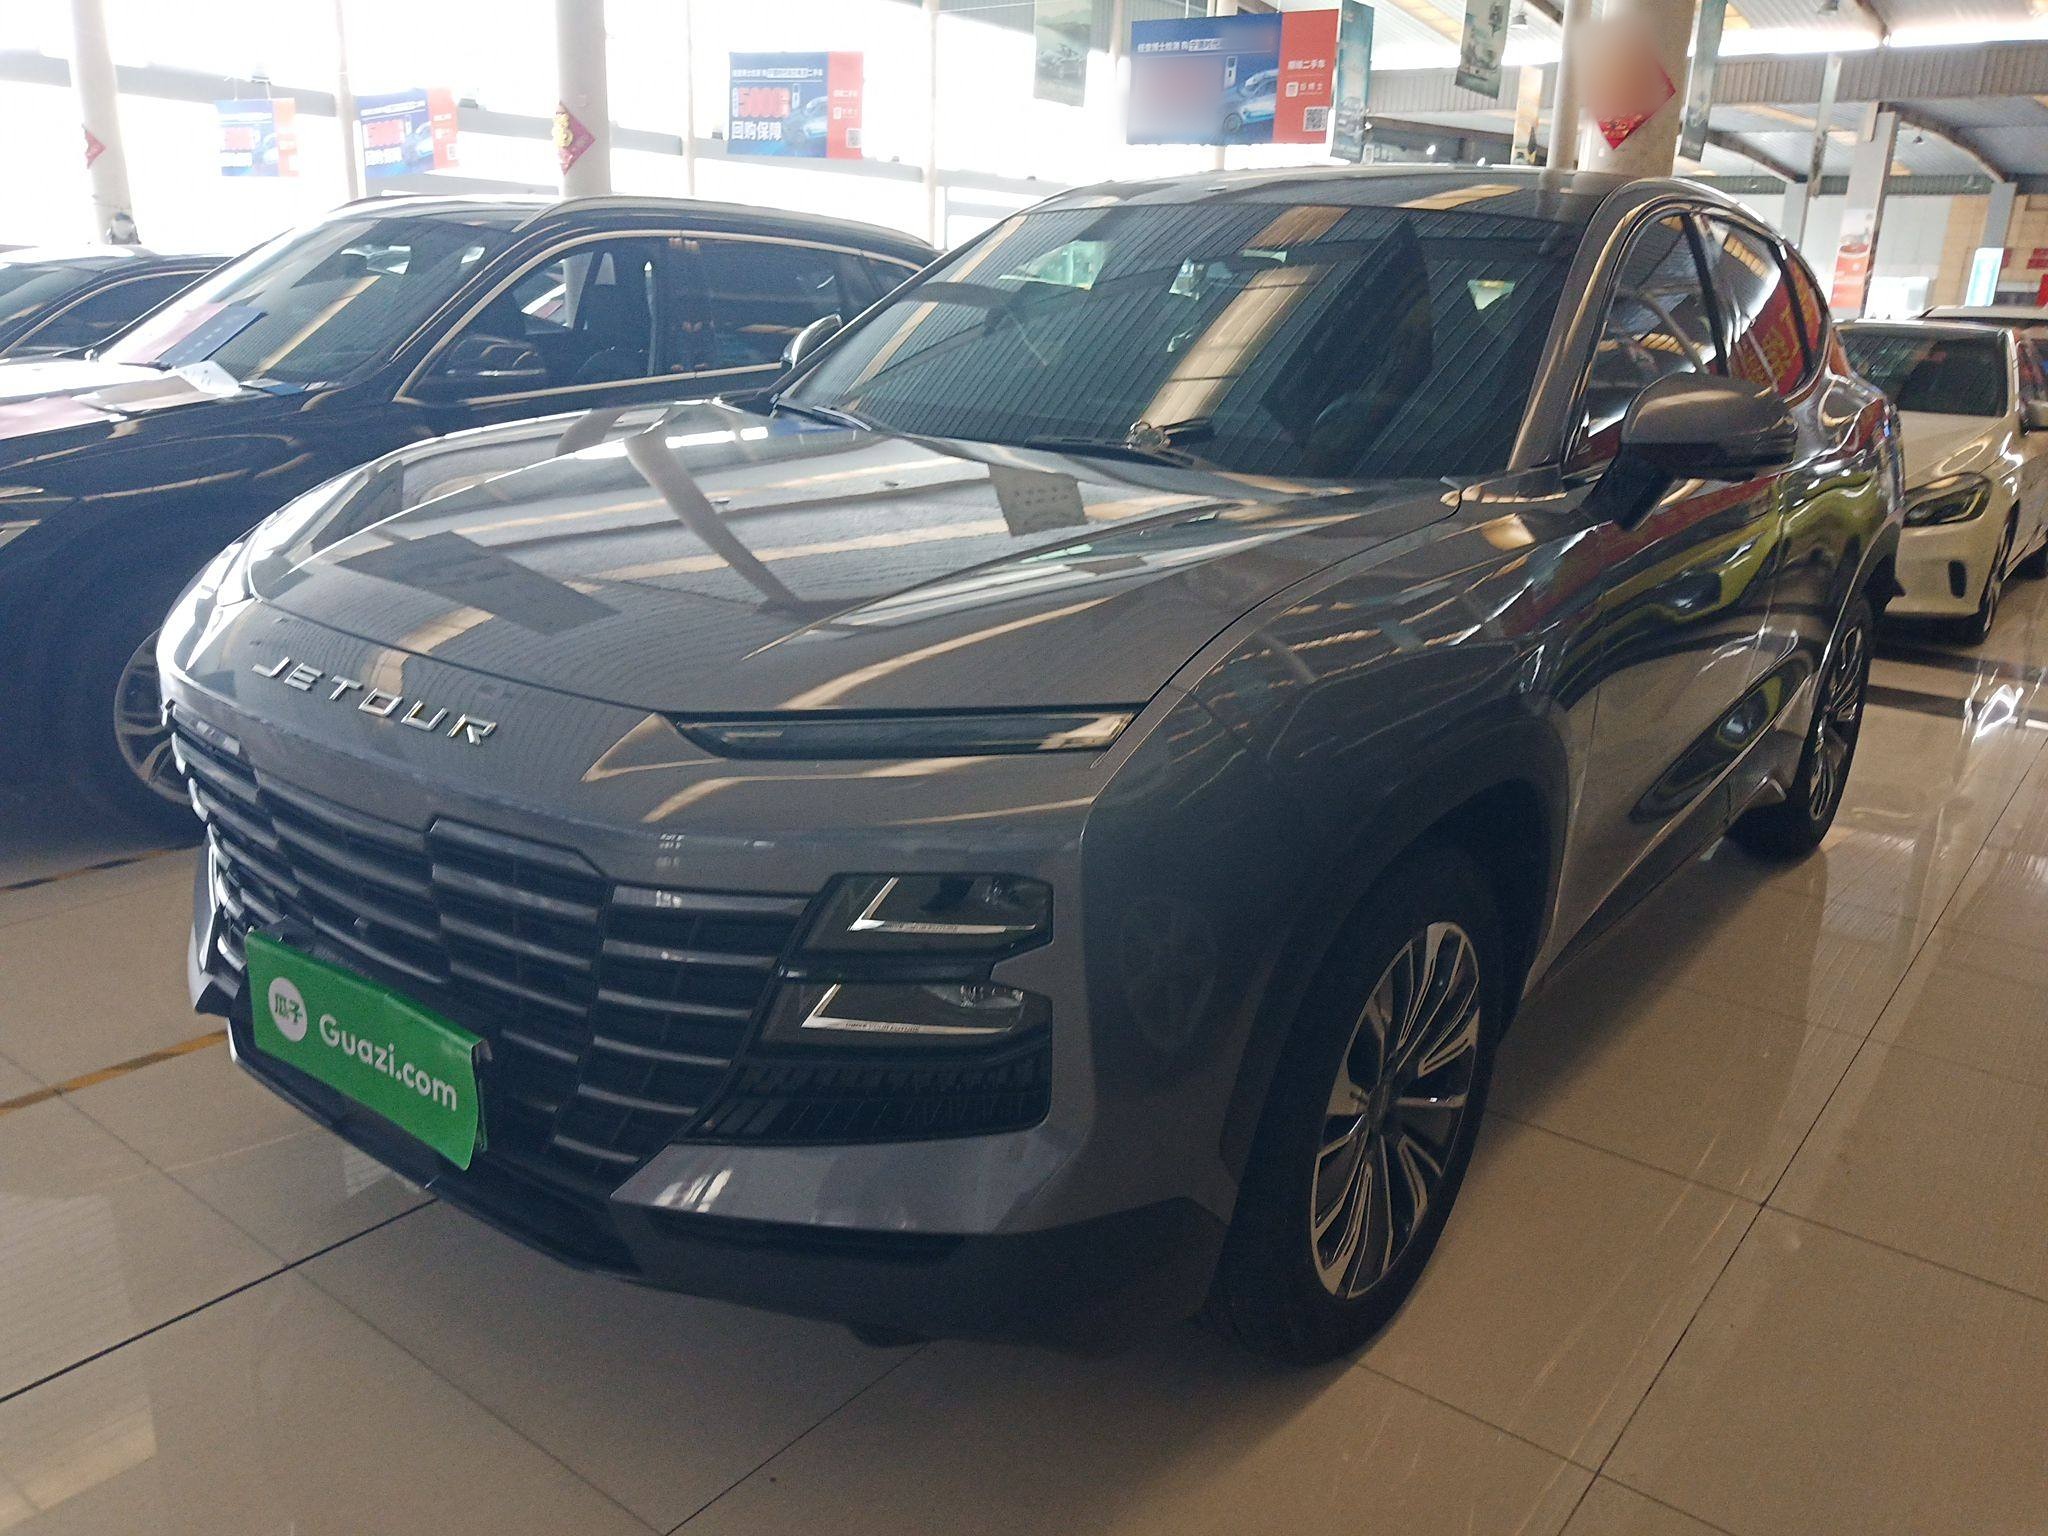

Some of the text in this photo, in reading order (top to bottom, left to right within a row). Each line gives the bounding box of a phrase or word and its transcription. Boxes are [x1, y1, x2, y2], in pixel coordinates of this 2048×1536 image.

[731, 120, 782, 141] 回购保障
[251, 656, 498, 745] JETOUR
[274, 993, 304, 1024] 瓜子
[319, 1013, 457, 1112] Guazi.com
